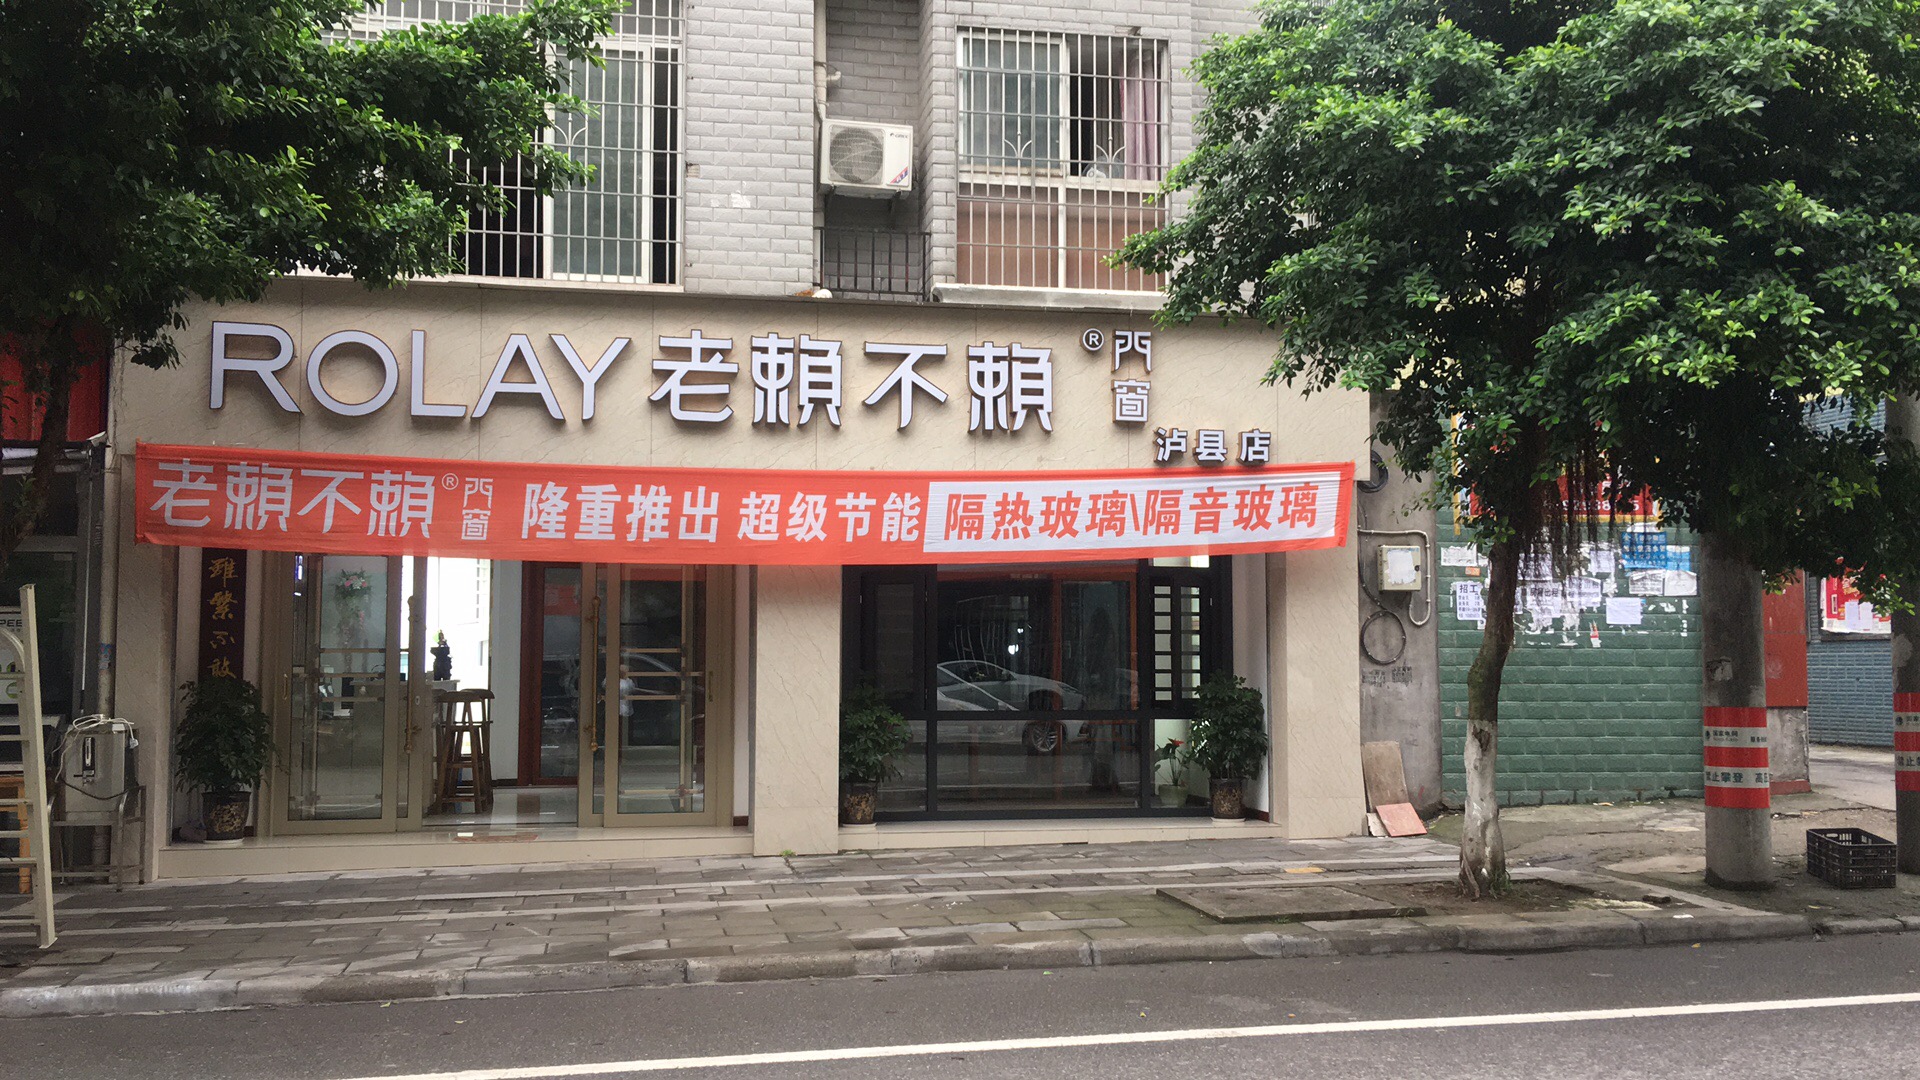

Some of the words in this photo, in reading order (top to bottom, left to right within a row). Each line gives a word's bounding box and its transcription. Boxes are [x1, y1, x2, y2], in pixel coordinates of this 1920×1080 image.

[208, 320, 632, 423] ROLAY
[648, 328, 1054, 432] 老賴不賴
[1154, 427, 1271, 462] 泸县店
[150, 458, 436, 538] 老賴不賴
[521, 481, 720, 543] 隆重推出
[737, 491, 922, 543] 超级节能
[1460, 584, 1479, 594] 招工
